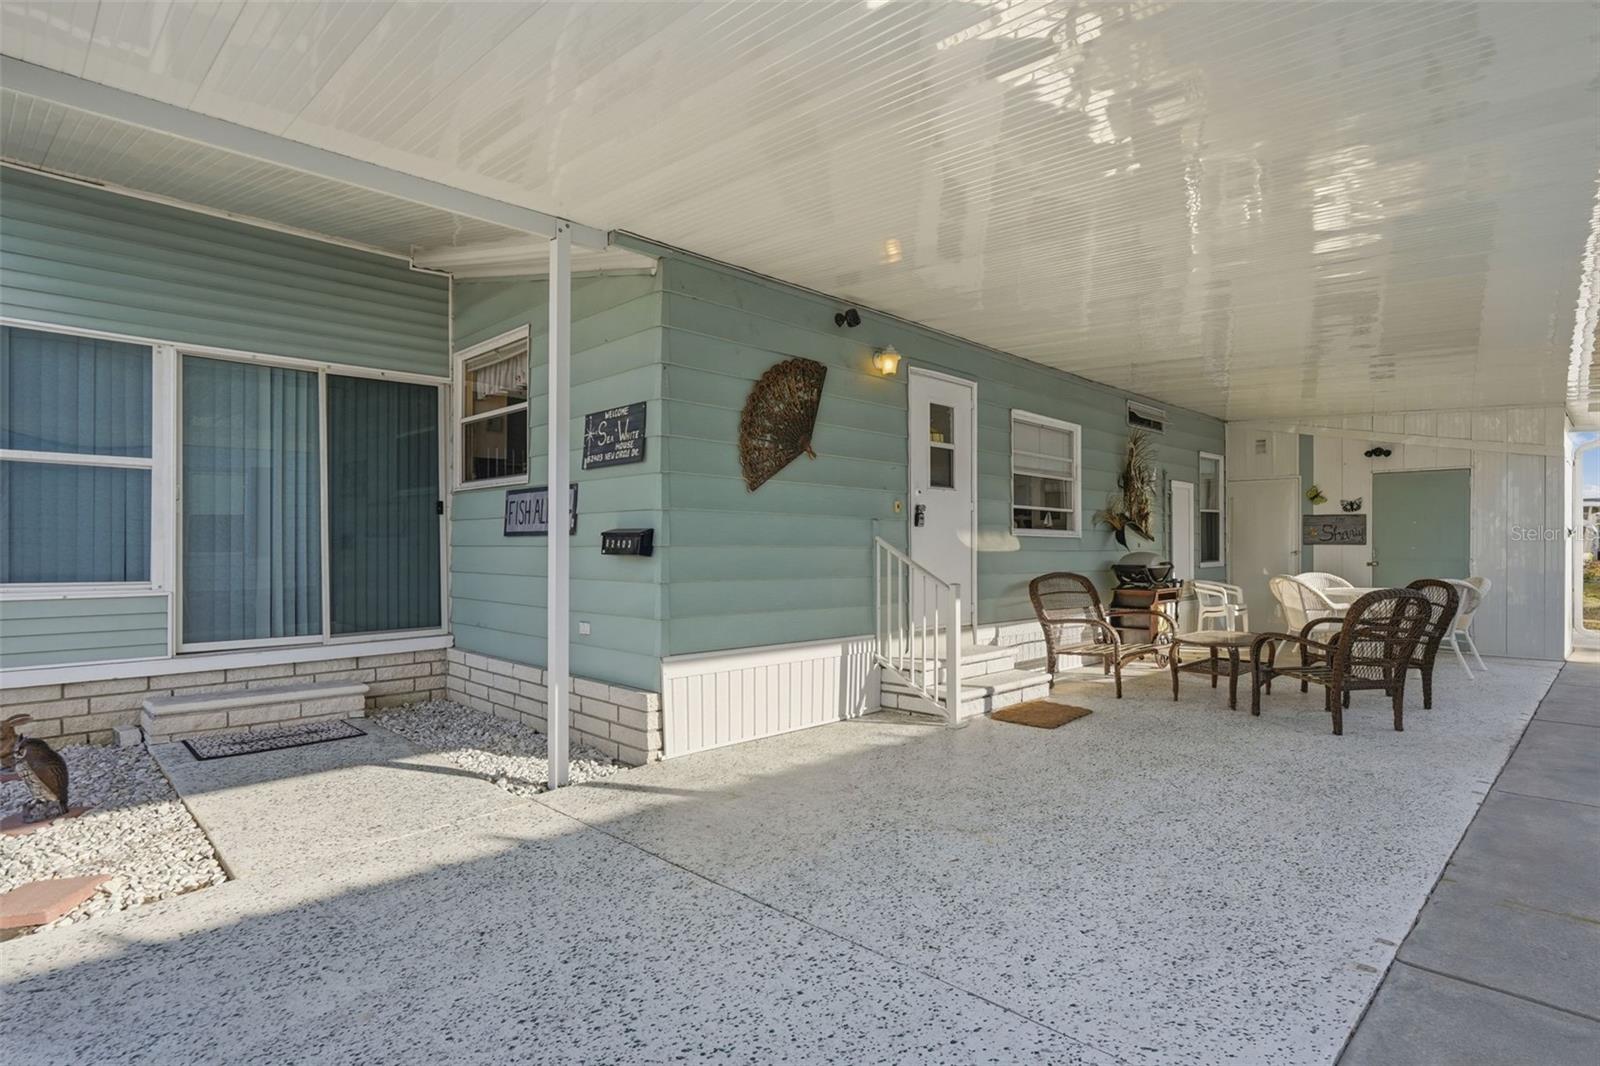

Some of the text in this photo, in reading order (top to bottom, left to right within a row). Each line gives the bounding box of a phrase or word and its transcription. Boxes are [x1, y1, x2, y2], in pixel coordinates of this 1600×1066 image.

[604, 407, 629, 419] WELCOME
[615, 440, 634, 450] HOUSE
[508, 499, 532, 526] FISH
